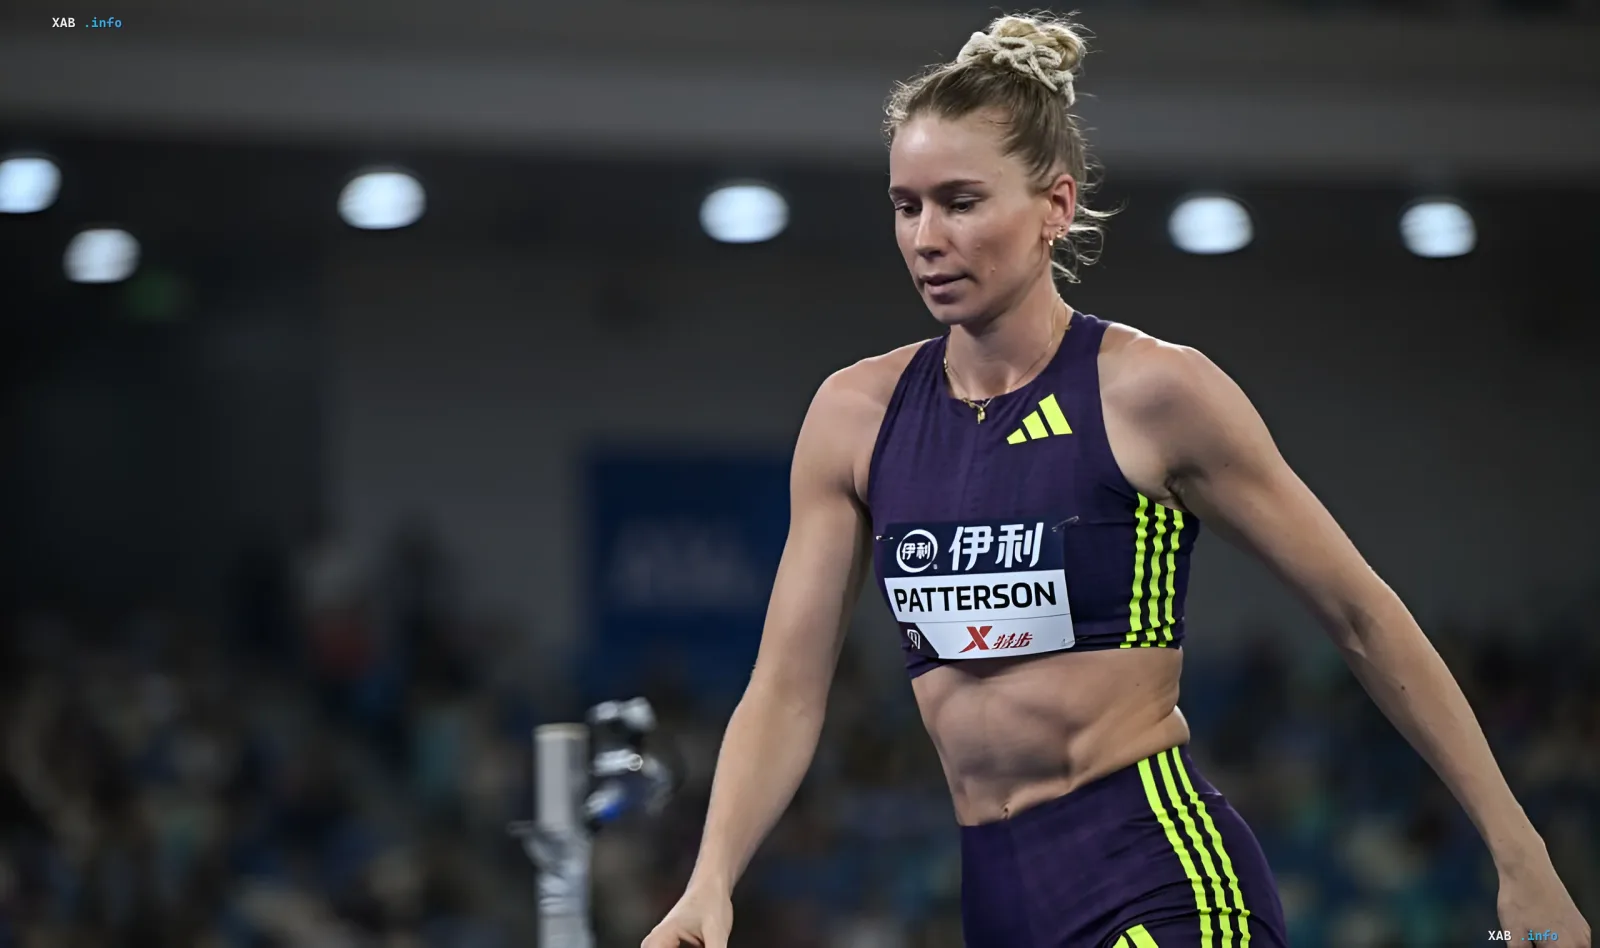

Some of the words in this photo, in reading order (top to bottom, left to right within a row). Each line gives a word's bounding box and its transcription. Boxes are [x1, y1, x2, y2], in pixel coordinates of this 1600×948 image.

[901, 541, 931, 560] 伊利
[948, 522, 1044, 571] 伊利
[893, 581, 1057, 613] PATTERSON
